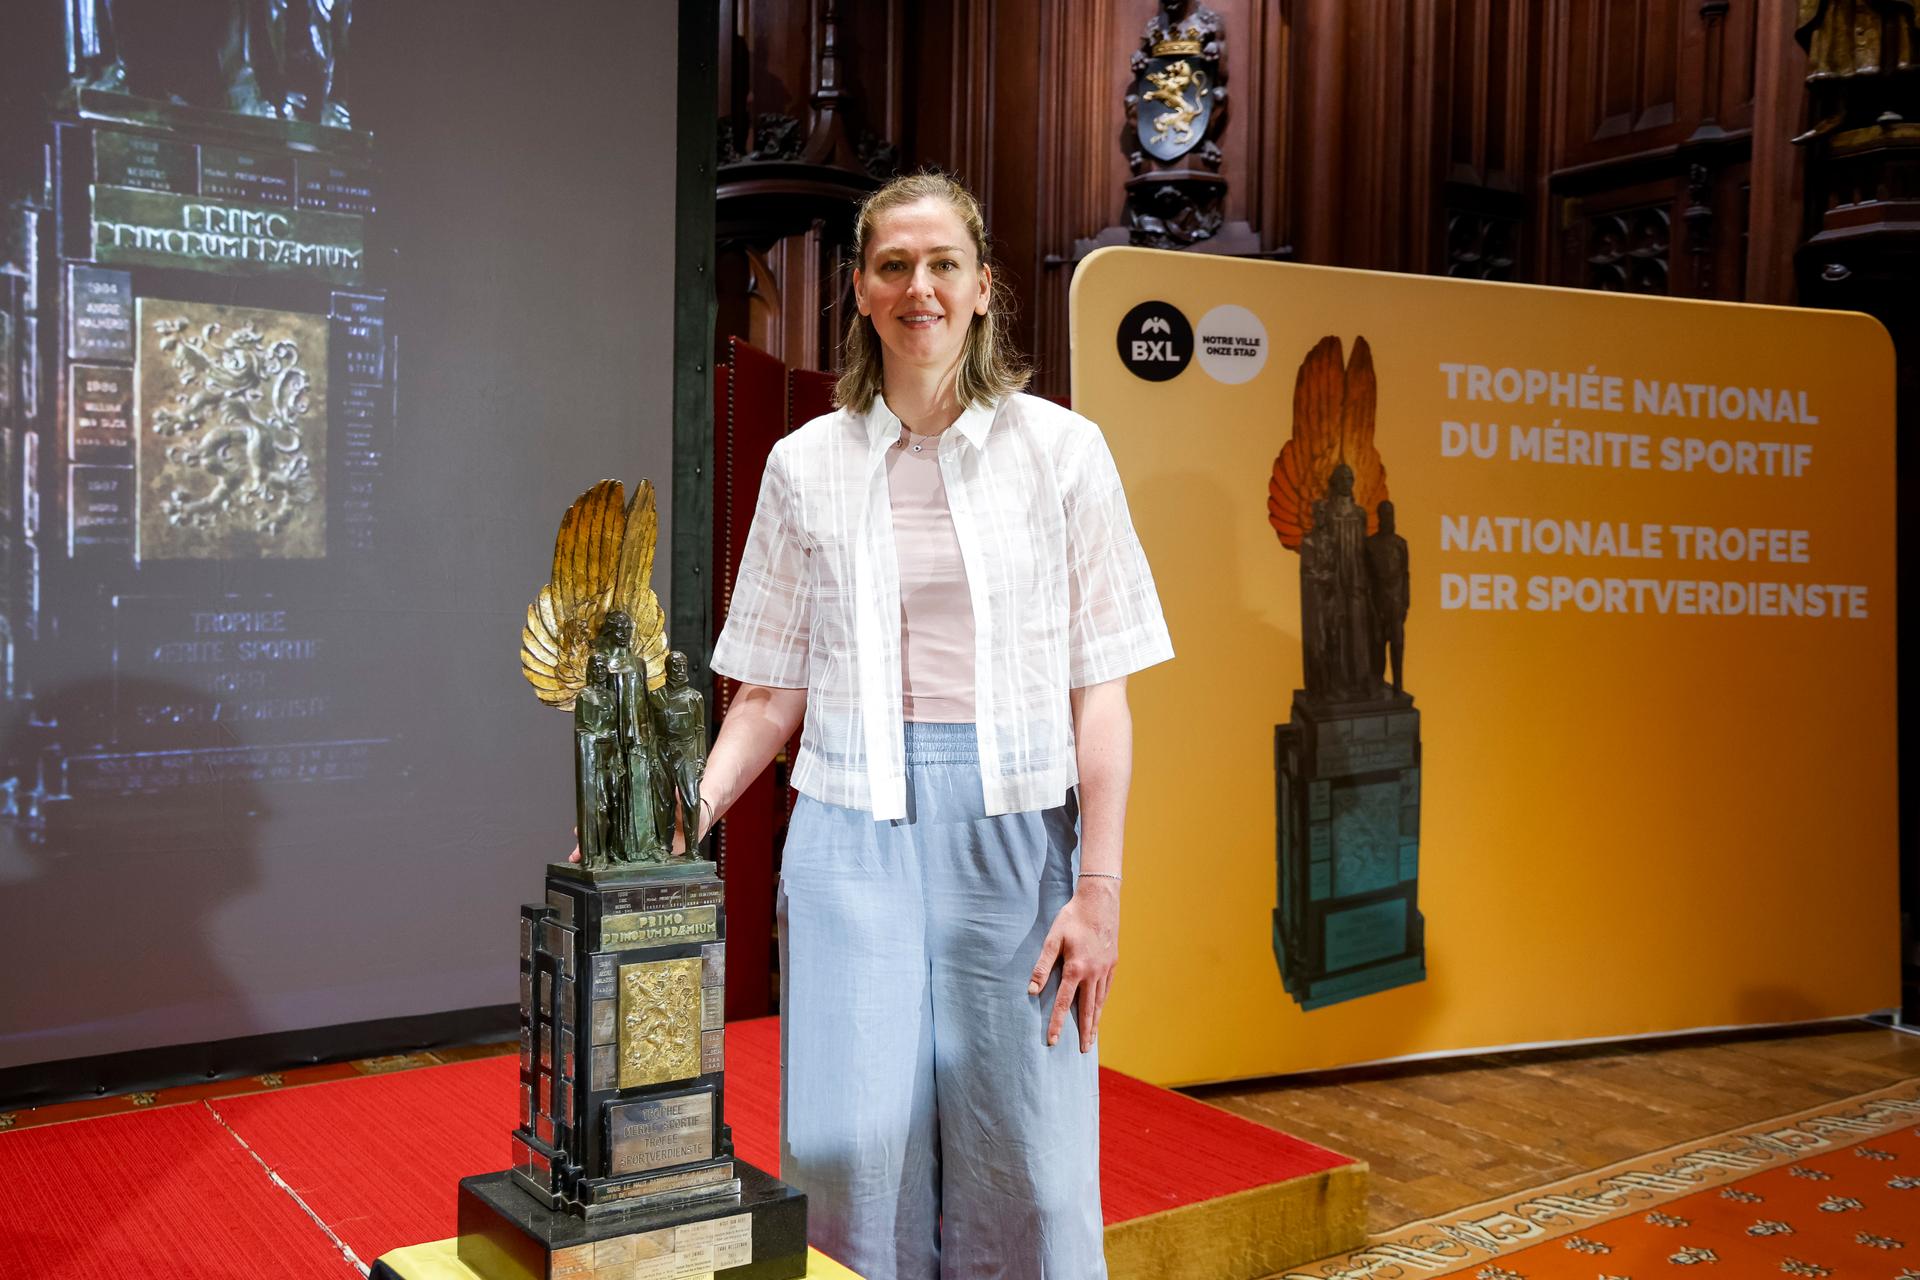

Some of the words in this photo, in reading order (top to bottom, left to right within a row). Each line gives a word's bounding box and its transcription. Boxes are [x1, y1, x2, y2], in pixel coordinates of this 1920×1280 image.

[1131, 340, 1181, 361] BXL
[1202, 335, 1234, 346] NOTRE
[1235, 337, 1260, 347] VILLE
[1206, 346, 1232, 356] ONZE
[1233, 348, 1257, 357] STAD
[1439, 362, 1624, 412] TROPHÉE
[1633, 378, 1819, 425] NATIONAL
[1440, 420, 1498, 459] DU
[1509, 418, 1651, 469] MÉRITE
[1660, 436, 1813, 478] SPORTIF
[1440, 514, 1663, 559] NATIONALE
[1669, 524, 1811, 564] TROFEE
[1440, 572, 1518, 611] DER
[1526, 576, 1869, 619] SPORTVERDIENSTE
[639, 913, 684, 929] PRIMO
